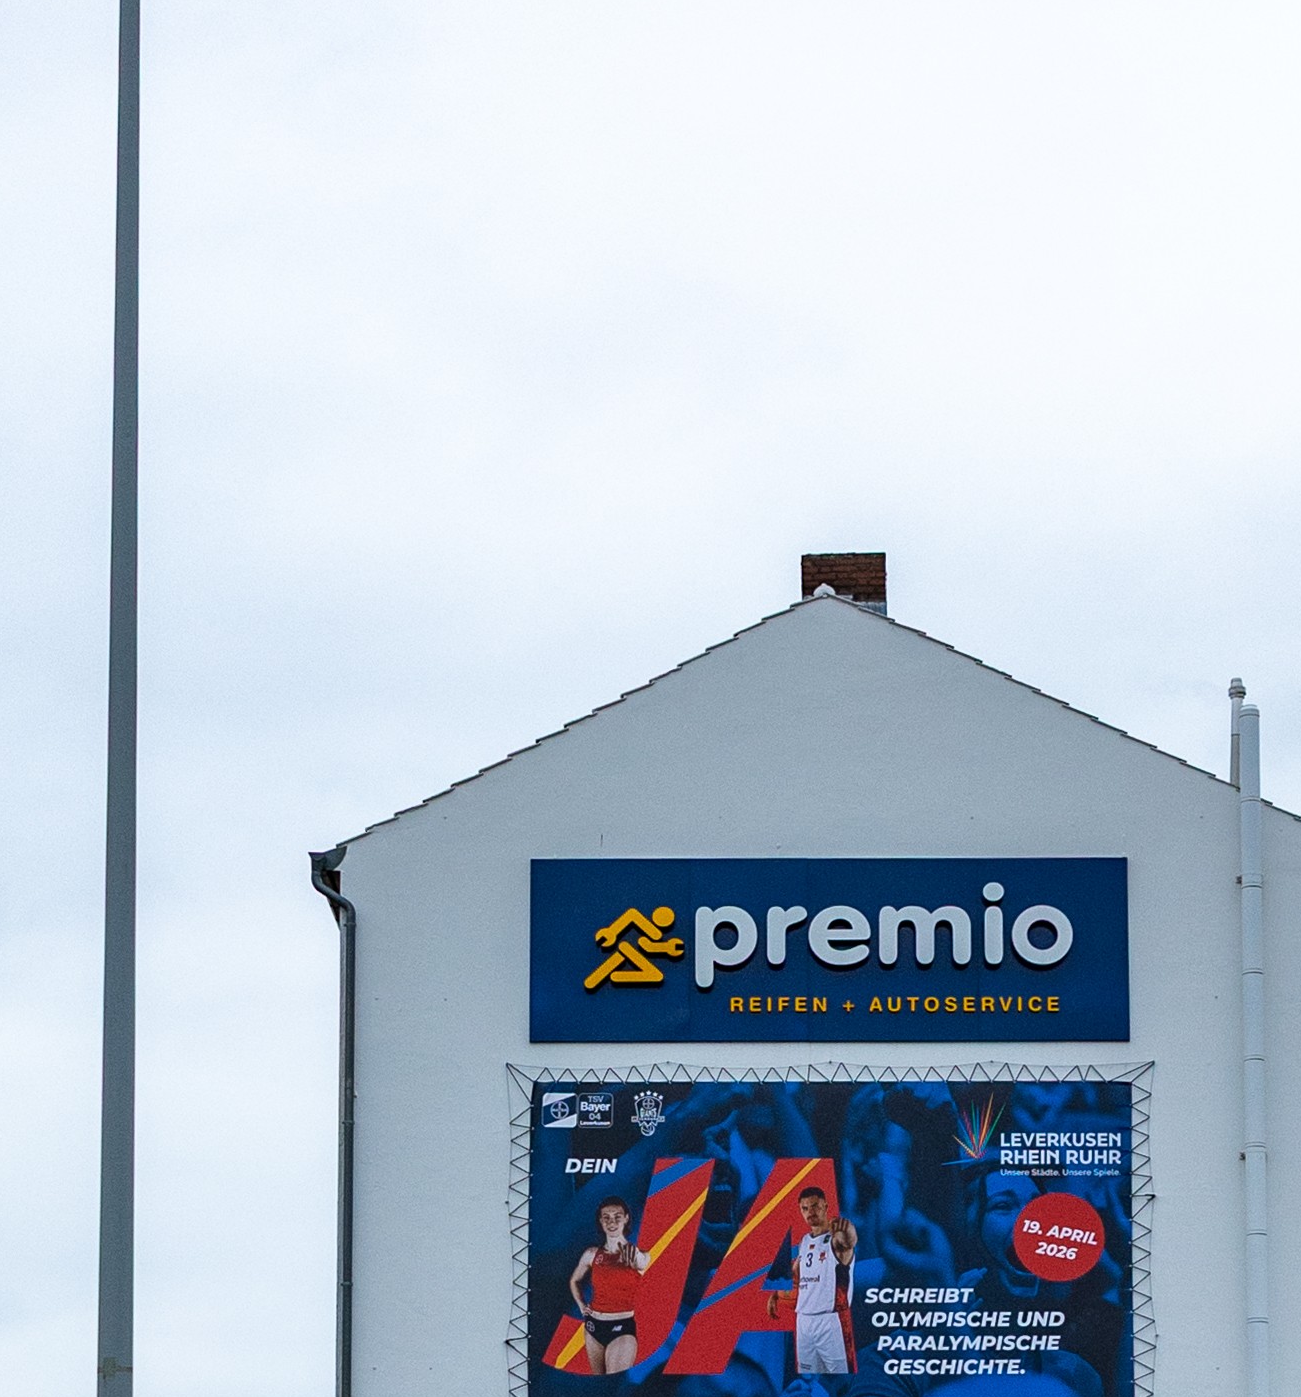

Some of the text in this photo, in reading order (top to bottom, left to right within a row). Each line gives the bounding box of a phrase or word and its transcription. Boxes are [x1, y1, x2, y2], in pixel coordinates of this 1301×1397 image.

[695, 882, 1074, 988] premio
[729, 995, 1061, 1014] REIFEN + AUTOSERVICE
[580, 1102, 611, 1112] Bayer
[1000, 1132, 1122, 1148] LEVERKUSEN
[1000, 1149, 1122, 1165] RHEIN RUHR
[565, 1158, 618, 1173] DEIN
[1022, 1219, 1098, 1246] 19. APRIL
[1035, 1241, 1079, 1260] 2026
[864, 1287, 974, 1304] SCHREIBT
[871, 1311, 1065, 1328] OLYMPISCHE UND
[877, 1335, 1061, 1351] PARALYMPISCHE
[883, 1359, 1026, 1375] GESCHICHTE.
